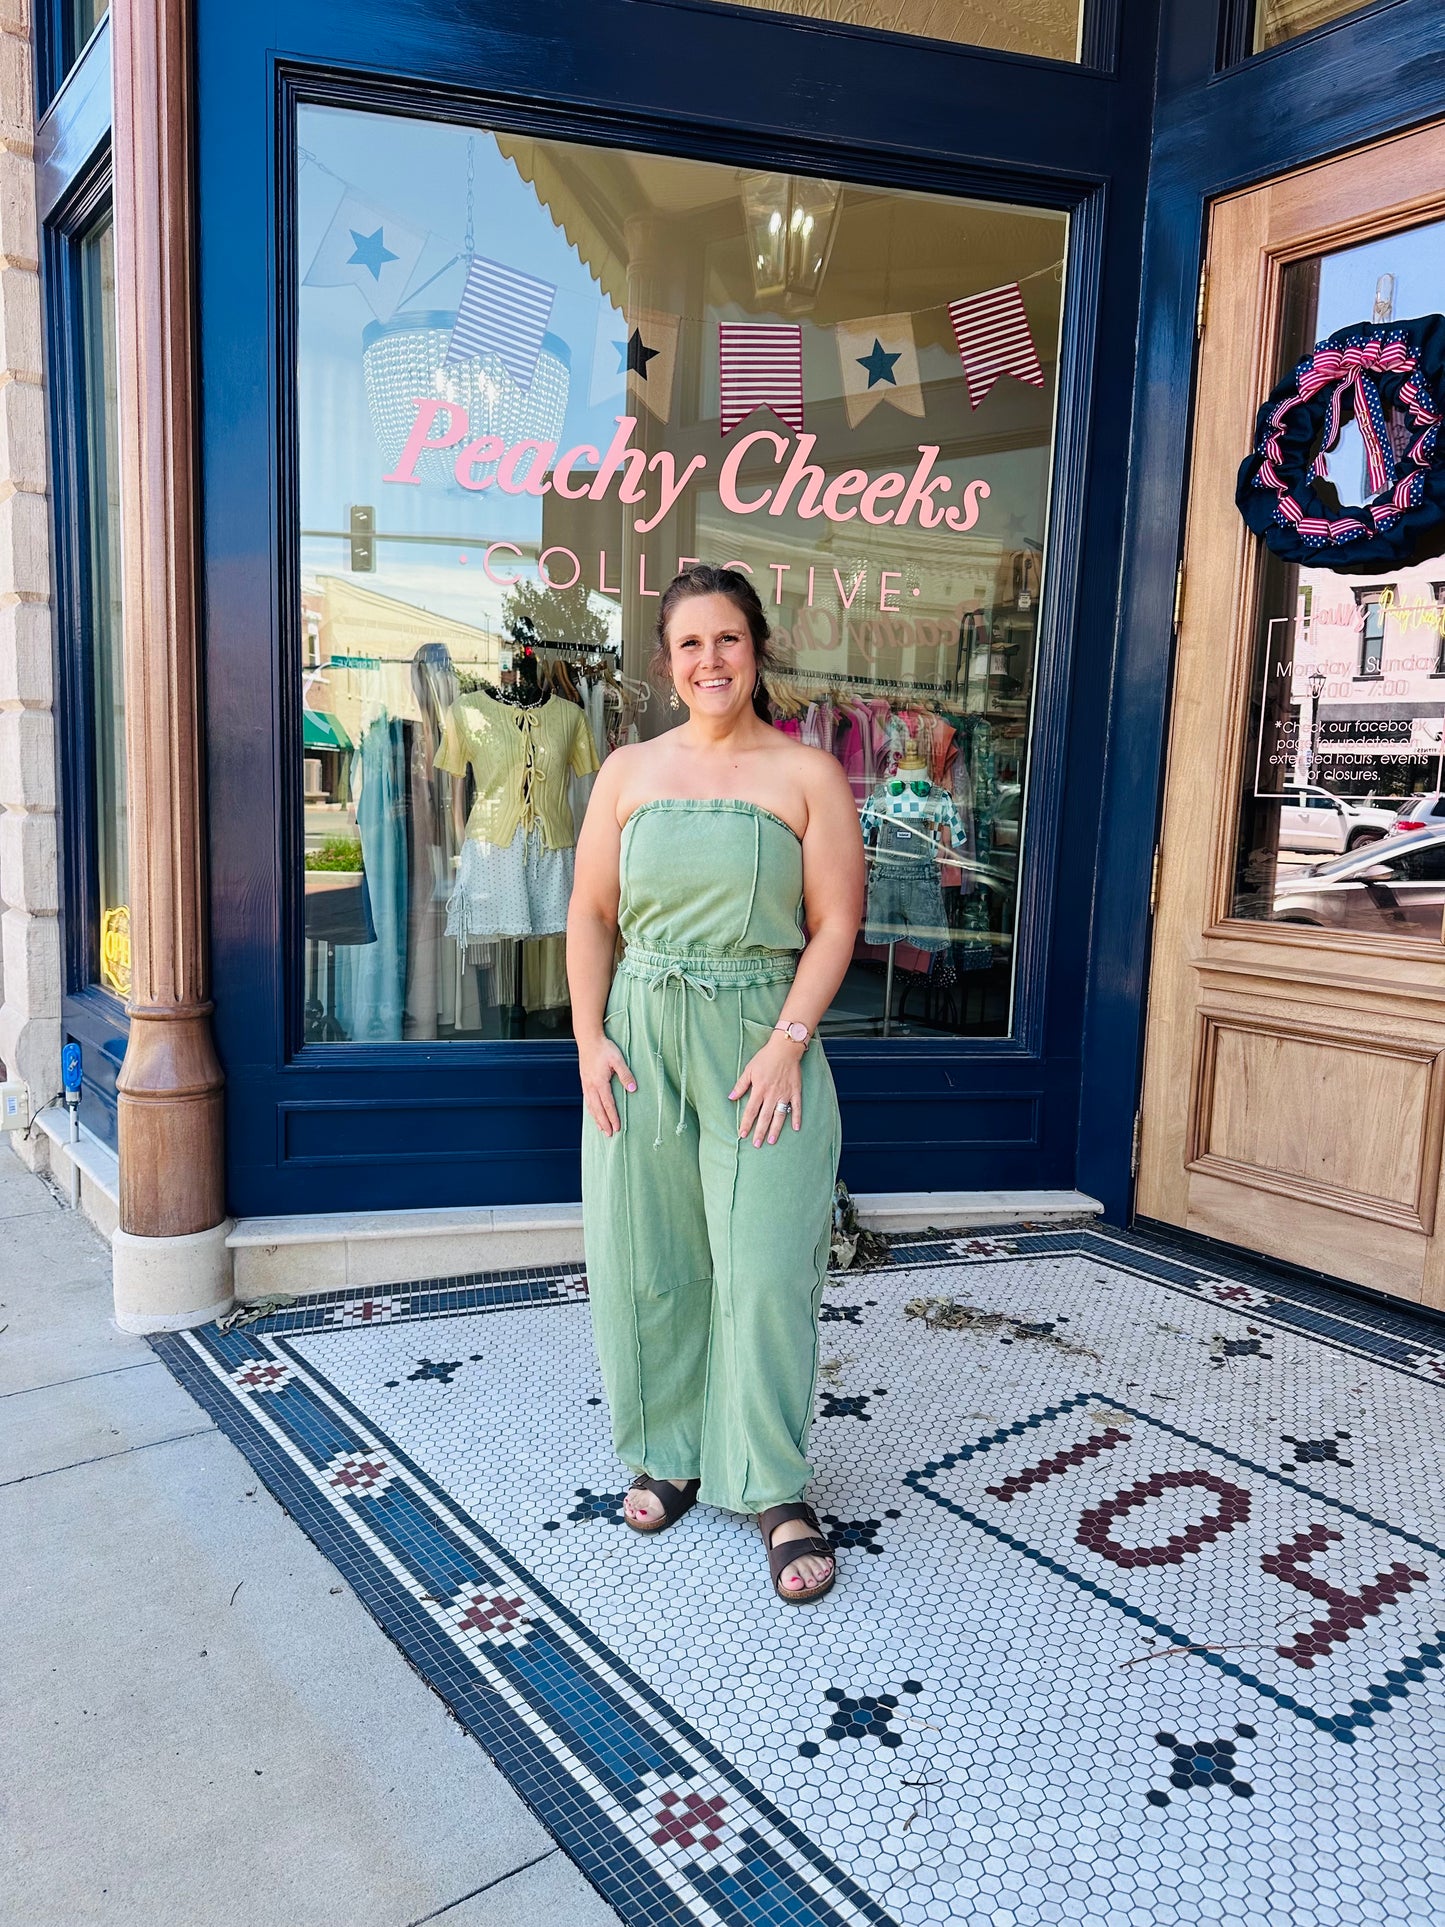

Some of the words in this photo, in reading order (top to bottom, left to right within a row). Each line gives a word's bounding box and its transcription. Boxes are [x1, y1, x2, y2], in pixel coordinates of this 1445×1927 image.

[382, 398, 707, 533] Peachy
[719, 430, 991, 532] Cheeks
[483, 542, 903, 612] COLLTIVE
[1293, 594, 1371, 646] Hours
[1276, 659, 1351, 678] Monday
[1366, 655, 1440, 674] Sunday
[1329, 723, 1352, 733] our
[1355, 720, 1427, 733] facebook
[1276, 739, 1313, 752] page
[1316, 737, 1336, 749] for
[1337, 736, 1396, 750] updates
[1400, 738, 1419, 749] on
[1307, 771, 1320, 780] or
[1323, 768, 1381, 781] closures.
[1336, 753, 1377, 766] hours,
[1380, 753, 1429, 765] events
[106, 931, 131, 969] OPE
[985, 1428, 1430, 1669] 104
